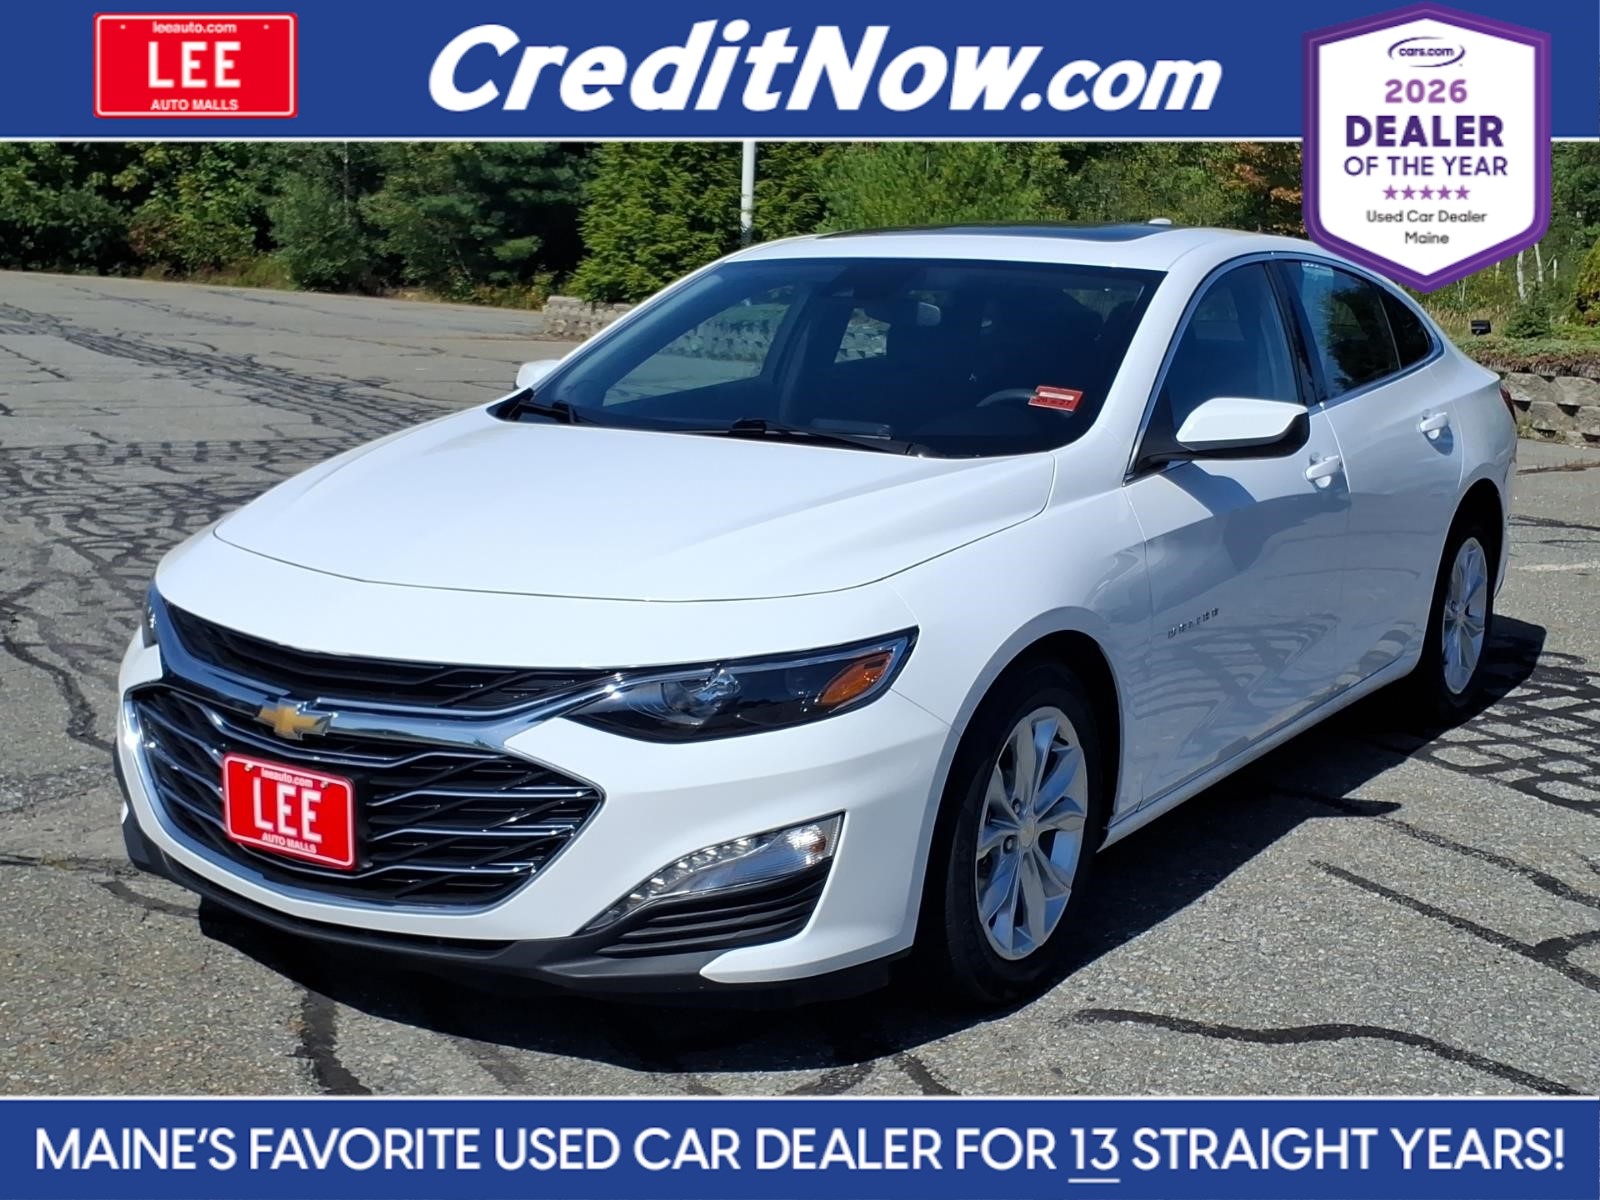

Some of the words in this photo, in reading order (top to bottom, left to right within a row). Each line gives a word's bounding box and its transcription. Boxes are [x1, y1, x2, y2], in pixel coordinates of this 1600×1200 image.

[252, 776, 323, 845] LEE
[261, 832, 286, 846] AUTO
[286, 839, 317, 854] MALLS
